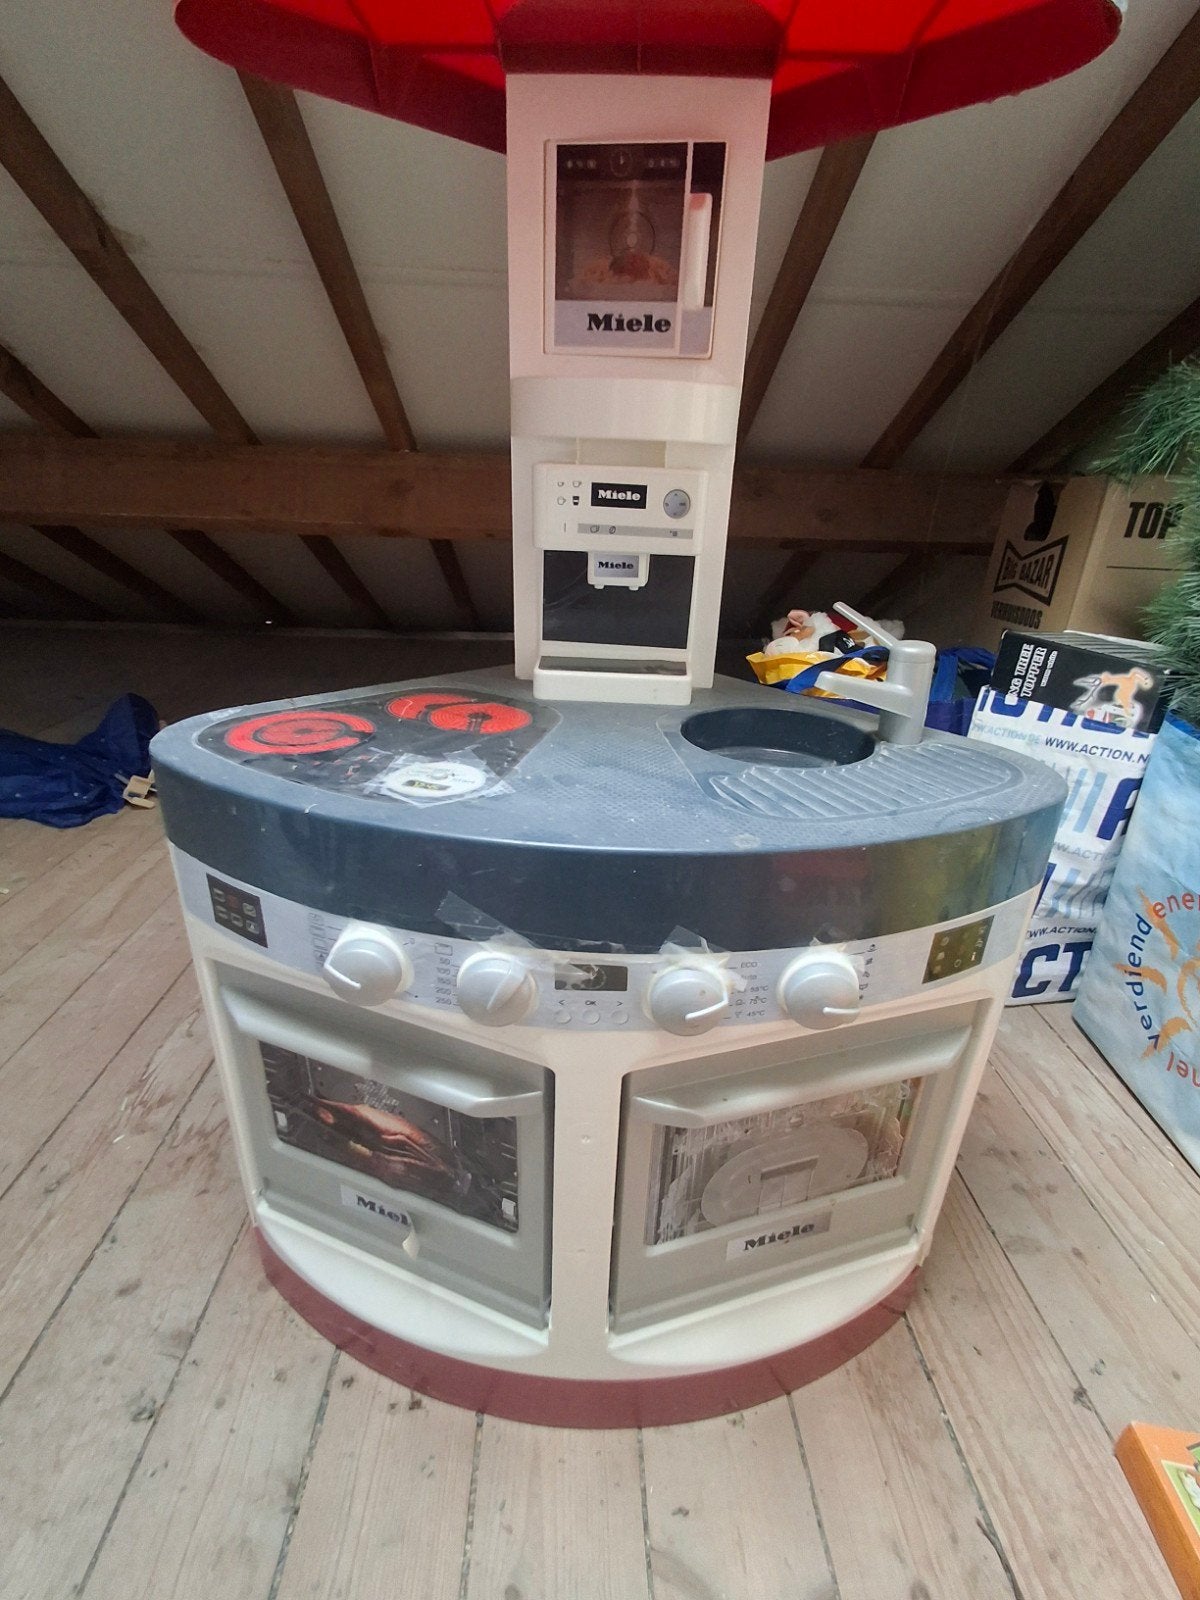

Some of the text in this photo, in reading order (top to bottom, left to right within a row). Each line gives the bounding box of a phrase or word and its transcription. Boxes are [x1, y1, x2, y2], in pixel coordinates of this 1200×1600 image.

[587, 313, 672, 333] Miele
[597, 489, 641, 501] Miele
[597, 560, 634, 570] Miele
[1002, 554, 1055, 590] BIG BAZAR
[1008, 643, 1035, 697] NG TREE
[1020, 647, 1047, 697] TOPPER
[1125, 913, 1160, 1050] verdiend
[743, 1224, 815, 1251] Miele
